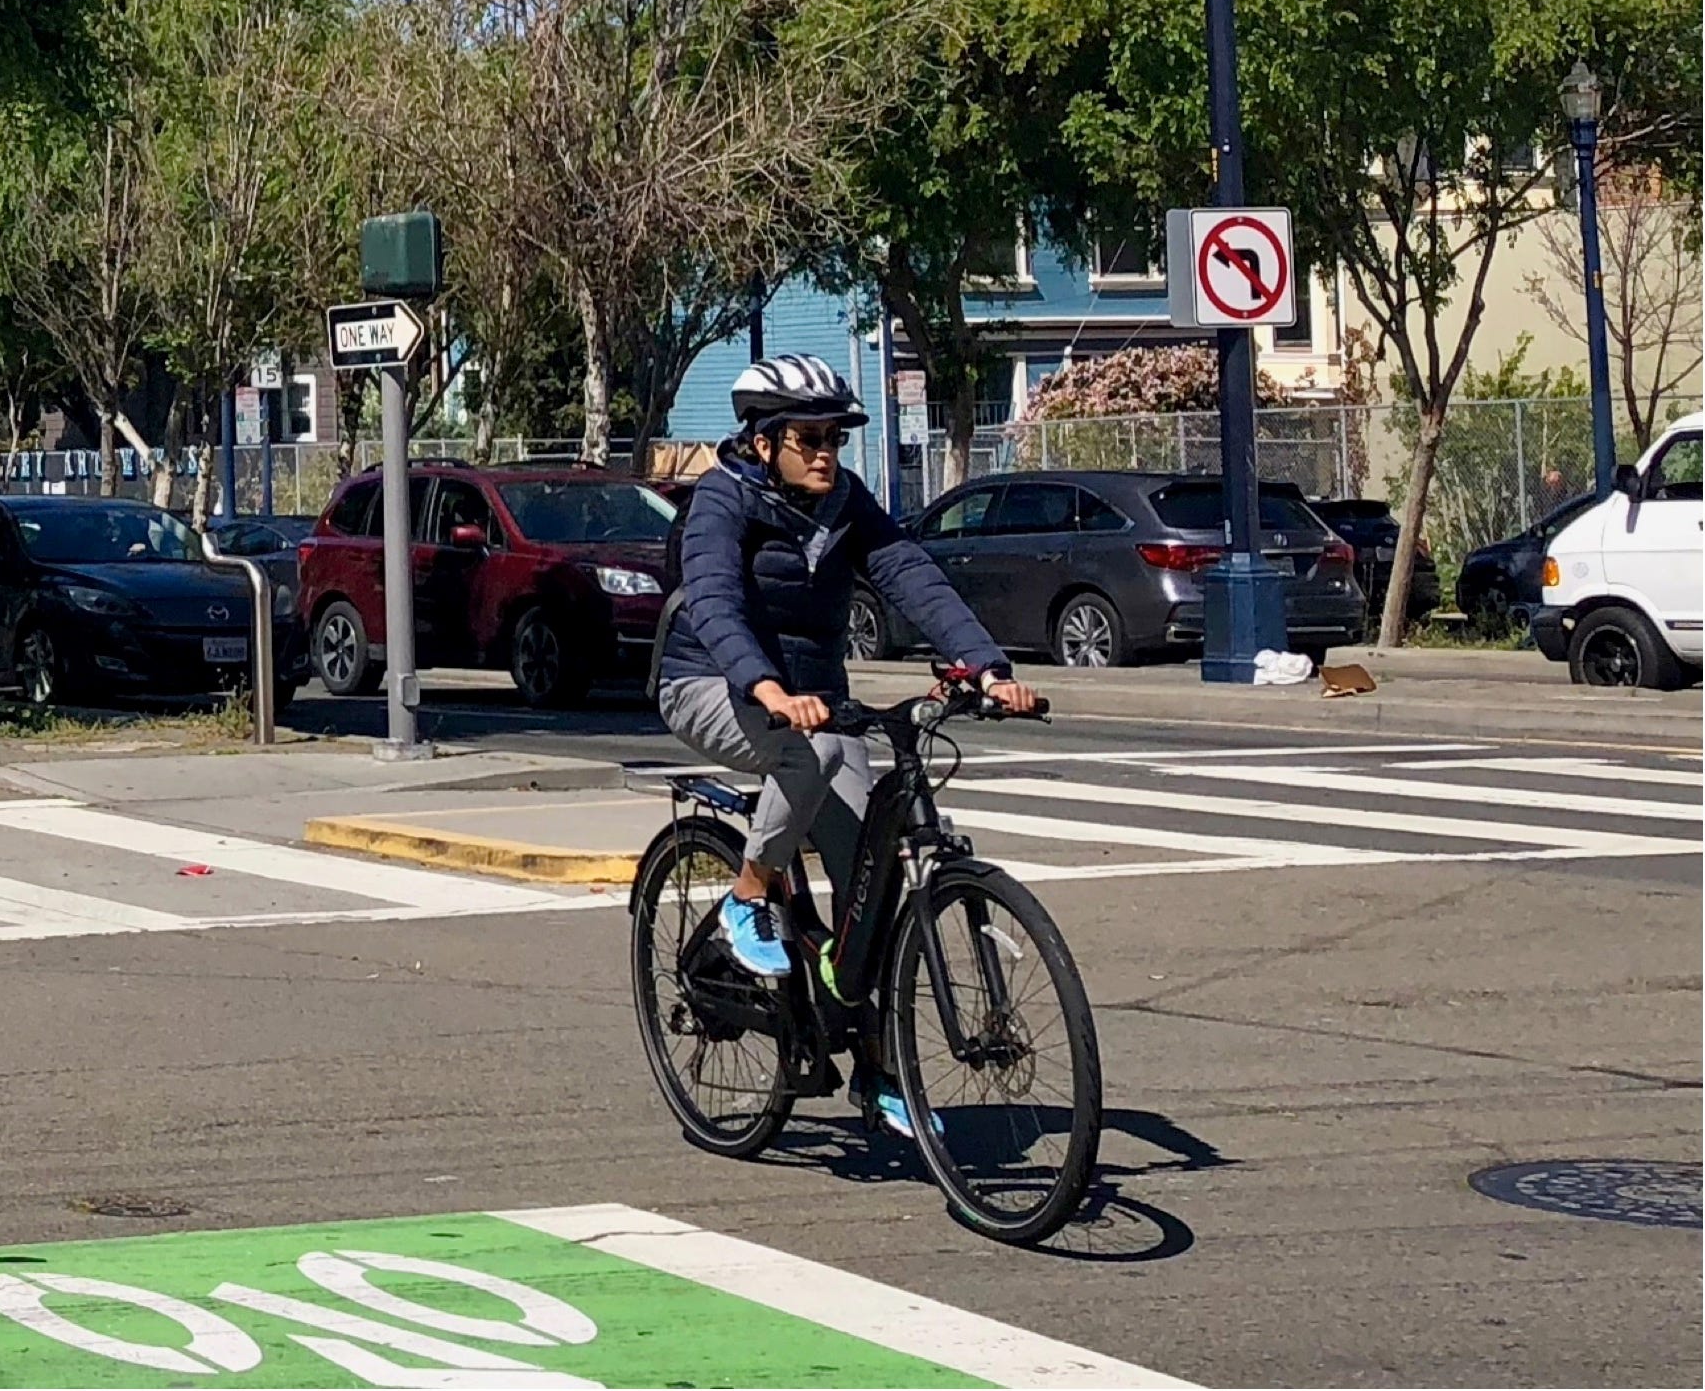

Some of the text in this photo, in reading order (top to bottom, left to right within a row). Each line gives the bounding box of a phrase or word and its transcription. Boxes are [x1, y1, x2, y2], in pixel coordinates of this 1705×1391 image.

[340, 322, 395, 348] ONE WAY
[258, 366, 277, 384] 15
